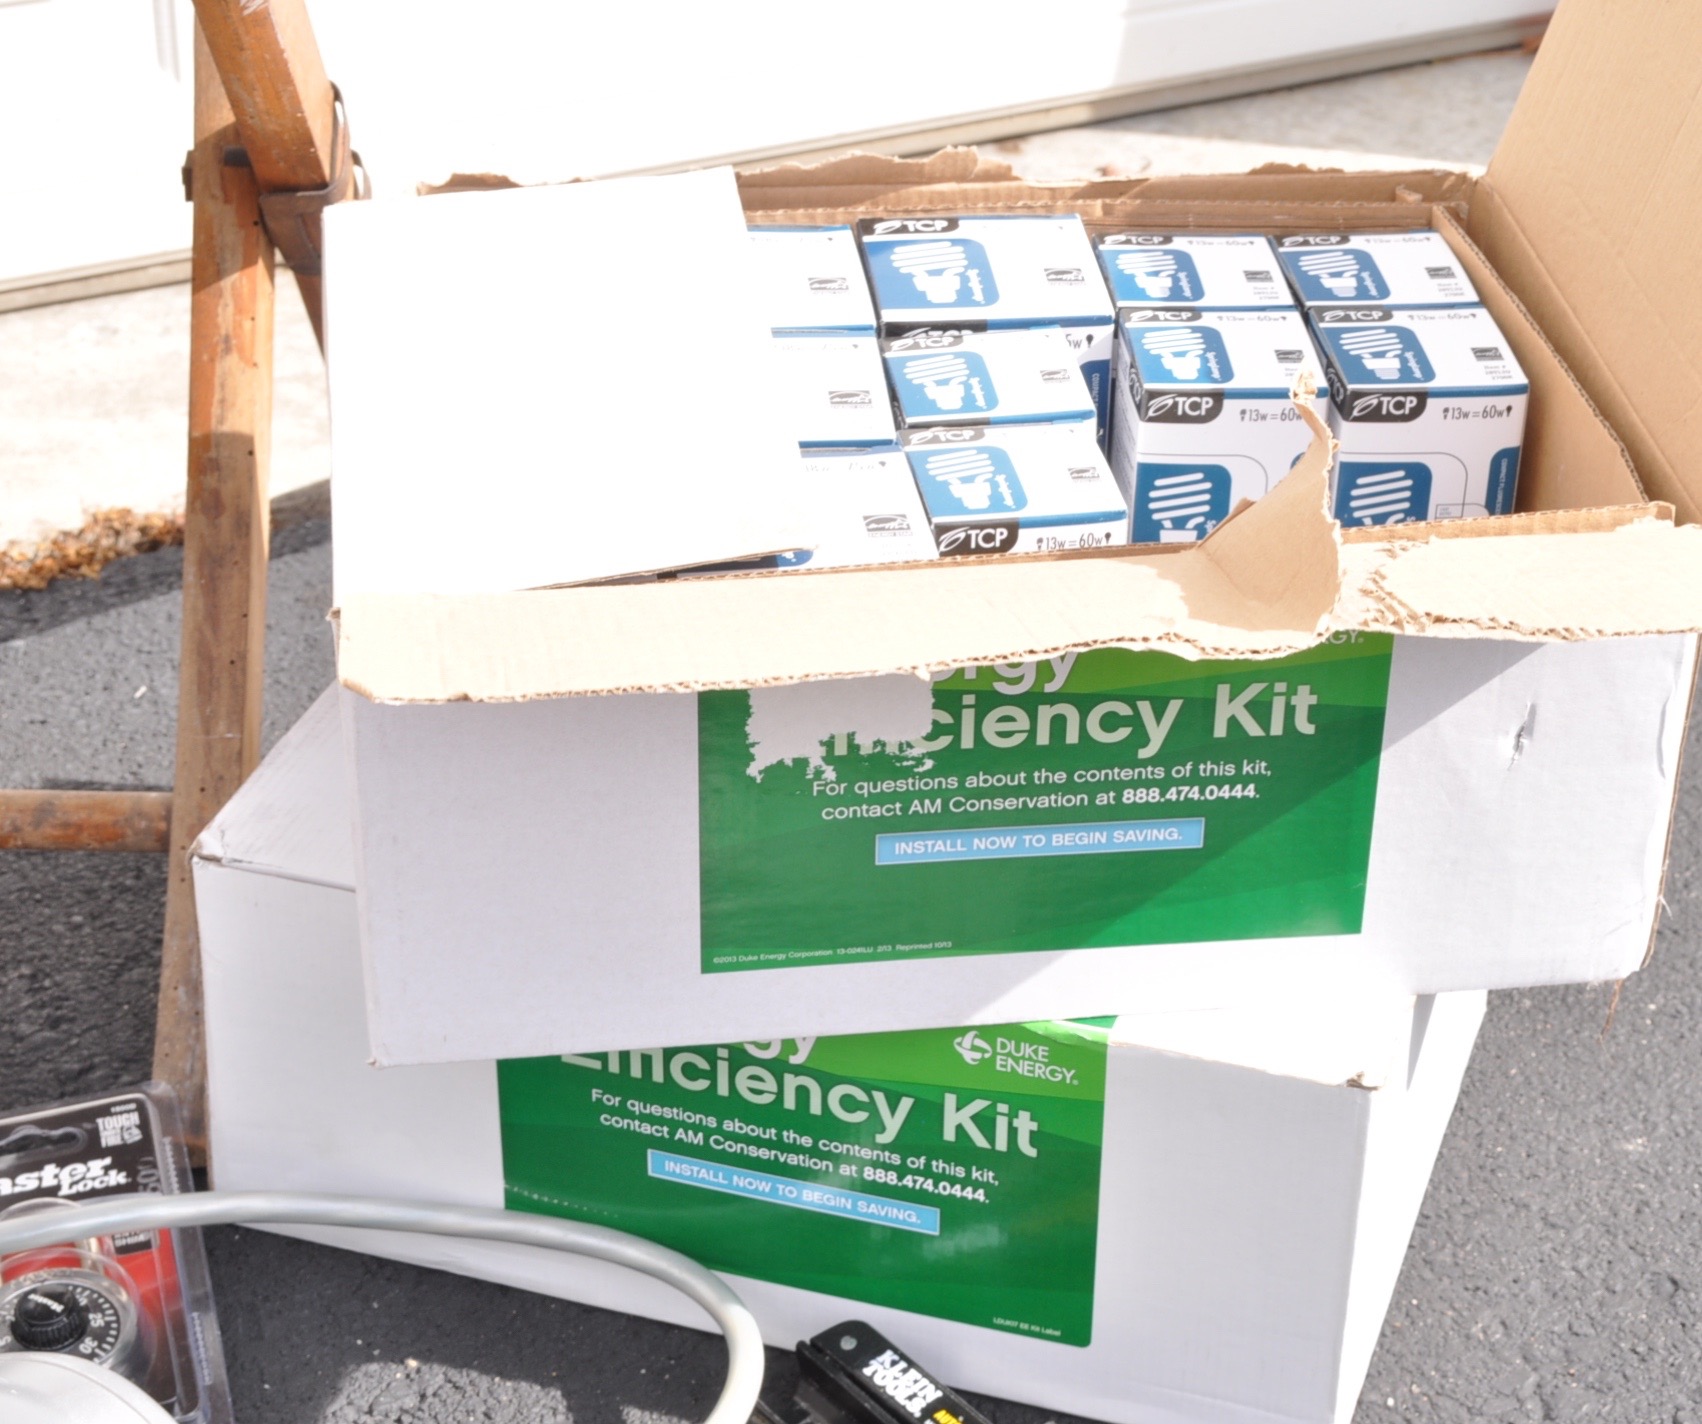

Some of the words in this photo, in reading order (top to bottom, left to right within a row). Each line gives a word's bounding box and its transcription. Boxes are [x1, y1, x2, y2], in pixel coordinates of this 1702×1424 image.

[903, 219, 950, 232] TCP
[1128, 235, 1164, 245] TCP
[1305, 235, 1342, 245] TCP
[1157, 311, 1193, 321] TCP
[1348, 310, 1384, 321] TCP
[919, 336, 954, 348] TCP
[1065, 333, 1083, 350] 5w
[1174, 397, 1214, 416] TCP
[1379, 395, 1418, 416] TCP
[938, 429, 976, 442] TCP
[967, 527, 1010, 549] TCP
[1212, 682, 1319, 739] Kit
[812, 780, 848, 796] For
[854, 775, 959, 798] questions
[965, 771, 1027, 788] about
[1033, 768, 1067, 784] the
[1073, 764, 1165, 783] contents
[1171, 761, 1193, 779] of
[1199, 760, 1236, 777] this
[1242, 759, 1272, 777] kit,
[821, 801, 902, 820] contact
[908, 798, 942, 815] AM
[949, 791, 1088, 814] Conservation
[1095, 790, 1116, 805] at
[1122, 783, 1260, 804] 888.474.0444.
[895, 838, 967, 855] INSTALL
[973, 836, 1018, 851] NOW
[1023, 834, 1046, 848] TO
[1052, 831, 1107, 847] BEGIN
[1113, 827, 1182, 843] SAVING.
[739, 953, 759, 962] Duke
[760, 952, 787, 961] Energy
[788, 949, 833, 959] Corporation
[895, 942, 933, 952] Reprinted
[996, 1036, 1049, 1062] DUKE
[995, 1055, 1077, 1085] ENERGY
[561, 1047, 916, 1144] iciency
[943, 1092, 1038, 1158] Kit
[591, 1088, 622, 1107] For
[627, 1096, 718, 1128] questions
[723, 1118, 778, 1141] about
[783, 1129, 814, 1148] the
[818, 1139, 901, 1166] contents
[906, 1155, 927, 1170] of
[931, 1159, 966, 1178] this
[971, 1165, 999, 1186] kit,
[600, 1113, 670, 1139] contact
[674, 1127, 704, 1146] AM
[709, 1134, 834, 1172] Conservation
[839, 1162, 858, 1178] at
[863, 1166, 990, 1204] 888.474.0444.
[0, 1156, 112, 1197] aster
[58, 1168, 128, 1197] Lock
[664, 1159, 729, 1184] INSTALL
[732, 1175, 773, 1193] NOW
[776, 1183, 798, 1199] TO
[801, 1189, 853, 1210] BEGIN
[857, 1200, 921, 1224] SAVING.
[89, 1312, 104, 1328] 25
[1041, 1326, 1062, 1337] Label
[79, 1336, 98, 1355] 30
[876, 1348, 944, 1403] KLEIN
